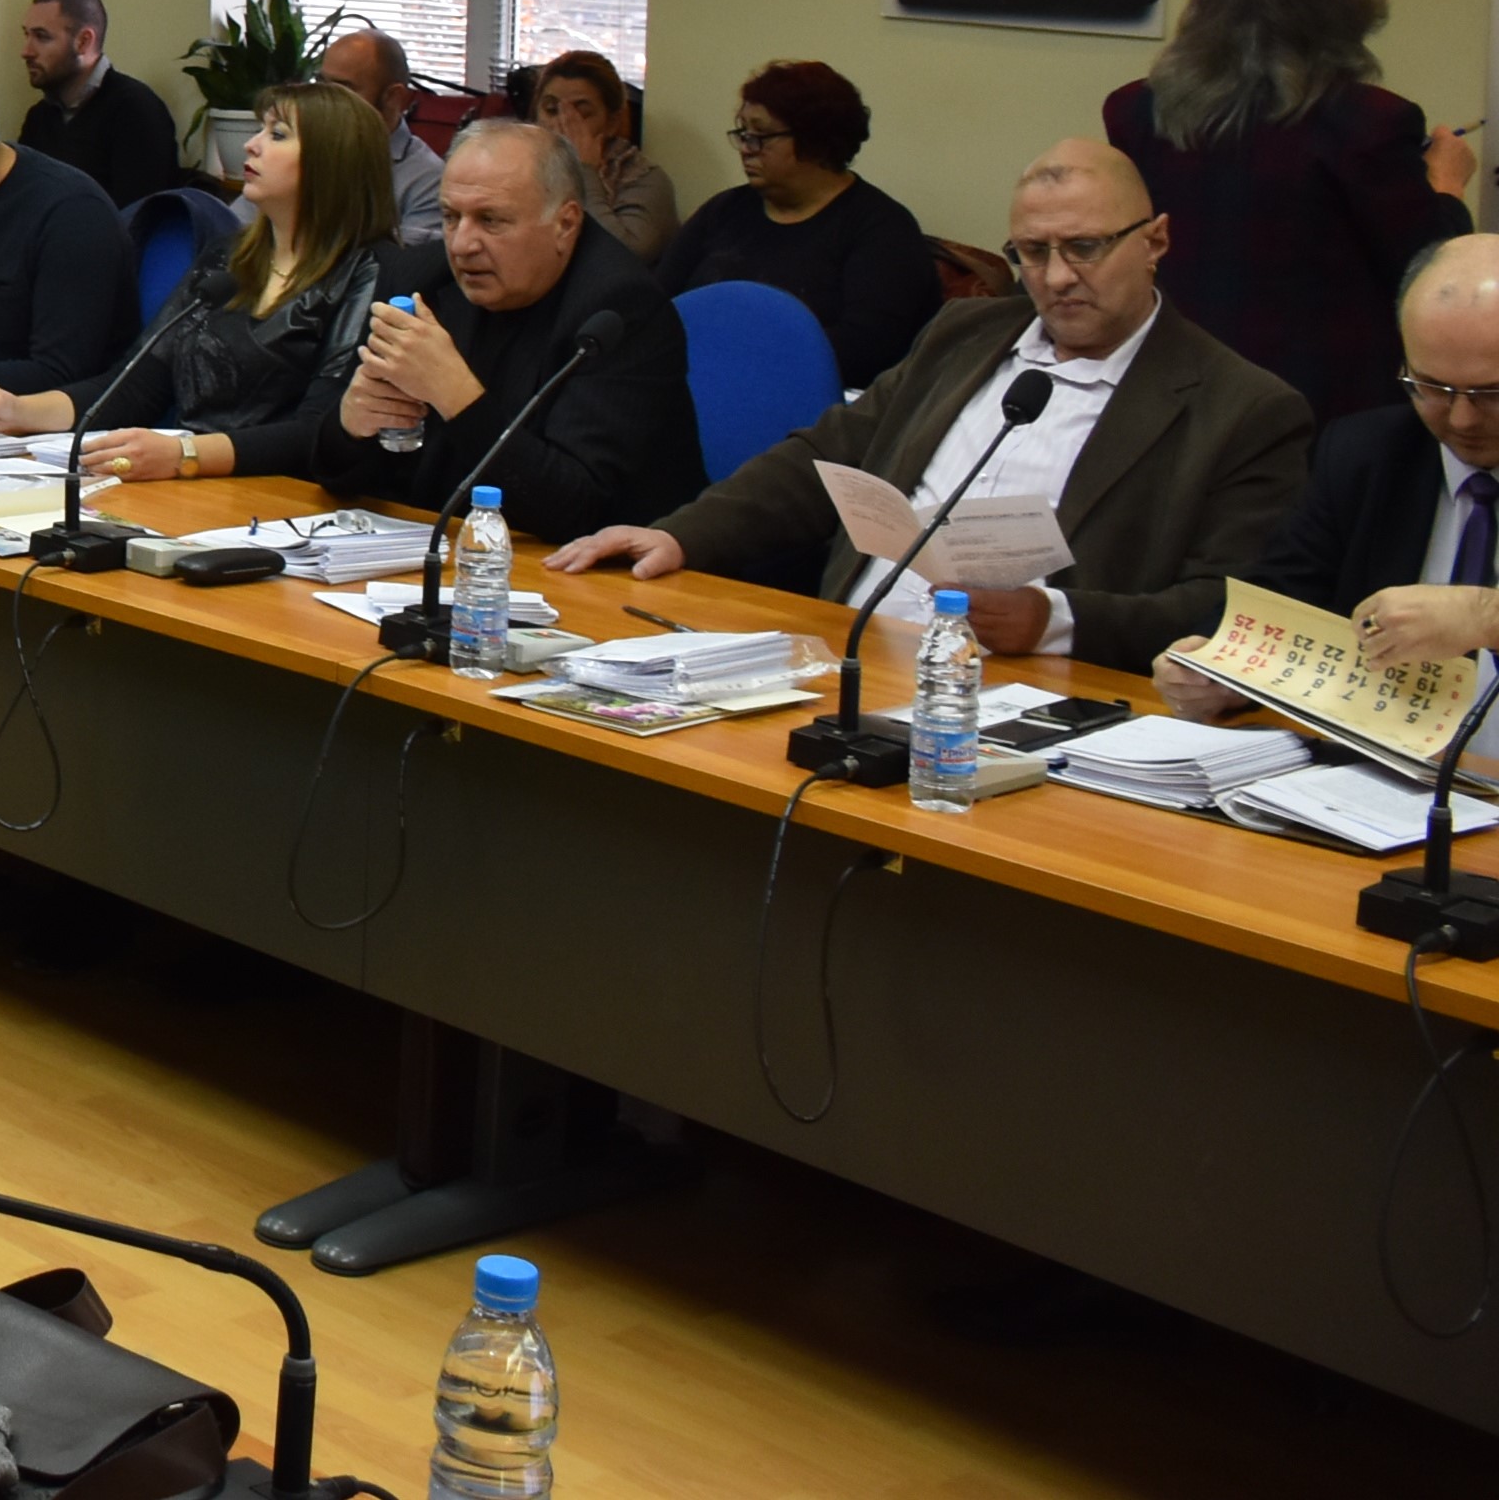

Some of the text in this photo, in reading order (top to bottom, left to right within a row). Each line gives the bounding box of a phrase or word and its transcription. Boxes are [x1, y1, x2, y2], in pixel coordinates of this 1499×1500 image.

[1234, 613, 1256, 631] 25
[1227, 630, 1248, 645] 18
[1263, 623, 1286, 641] 24
[1256, 640, 1278, 656] 17
[1293, 633, 1315, 652] 23
[1286, 650, 1307, 666] 16
[1322, 643, 1346, 662] 22
[1247, 655, 1268, 668] 10
[1315, 661, 1338, 677] 15
[1420, 661, 1444, 677] 26
[1282, 667, 1294, 678] 9
[1346, 671, 1368, 688] 14
[1384, 666, 1408, 684] 20
[1311, 678, 1325, 689] 8
[1377, 682, 1399, 699] 13
[1416, 677, 1438, 694] 19
[1373, 700, 1387, 712] 6
[1408, 693, 1431, 711] 12
[1405, 711, 1419, 724] 5
